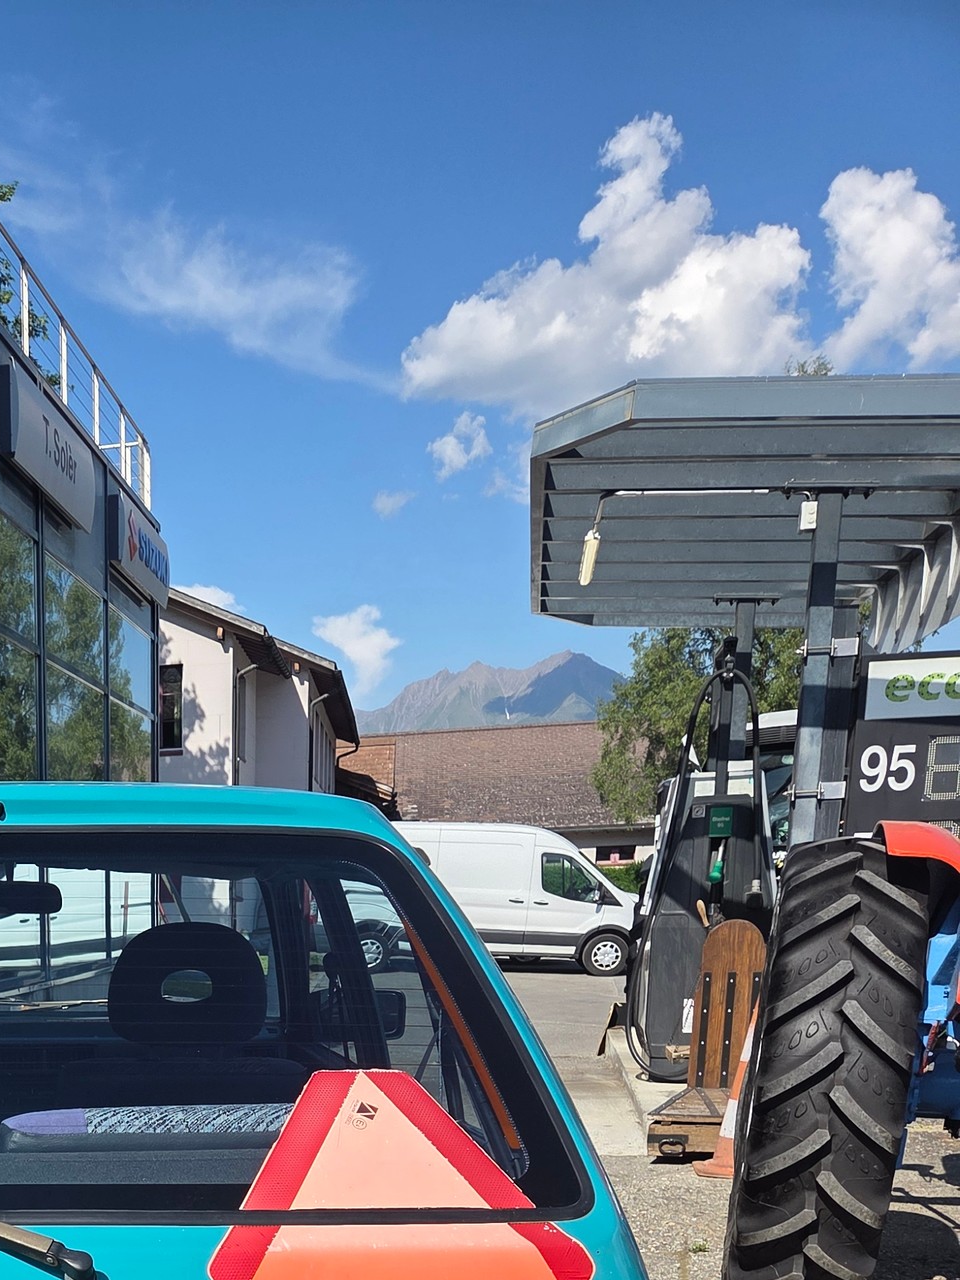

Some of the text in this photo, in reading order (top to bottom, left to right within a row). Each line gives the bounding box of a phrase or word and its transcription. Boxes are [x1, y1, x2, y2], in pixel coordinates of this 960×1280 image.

[42, 414, 52, 458] T.
[139, 527, 169, 588] SUZUKI
[859, 744, 916, 793] 95
